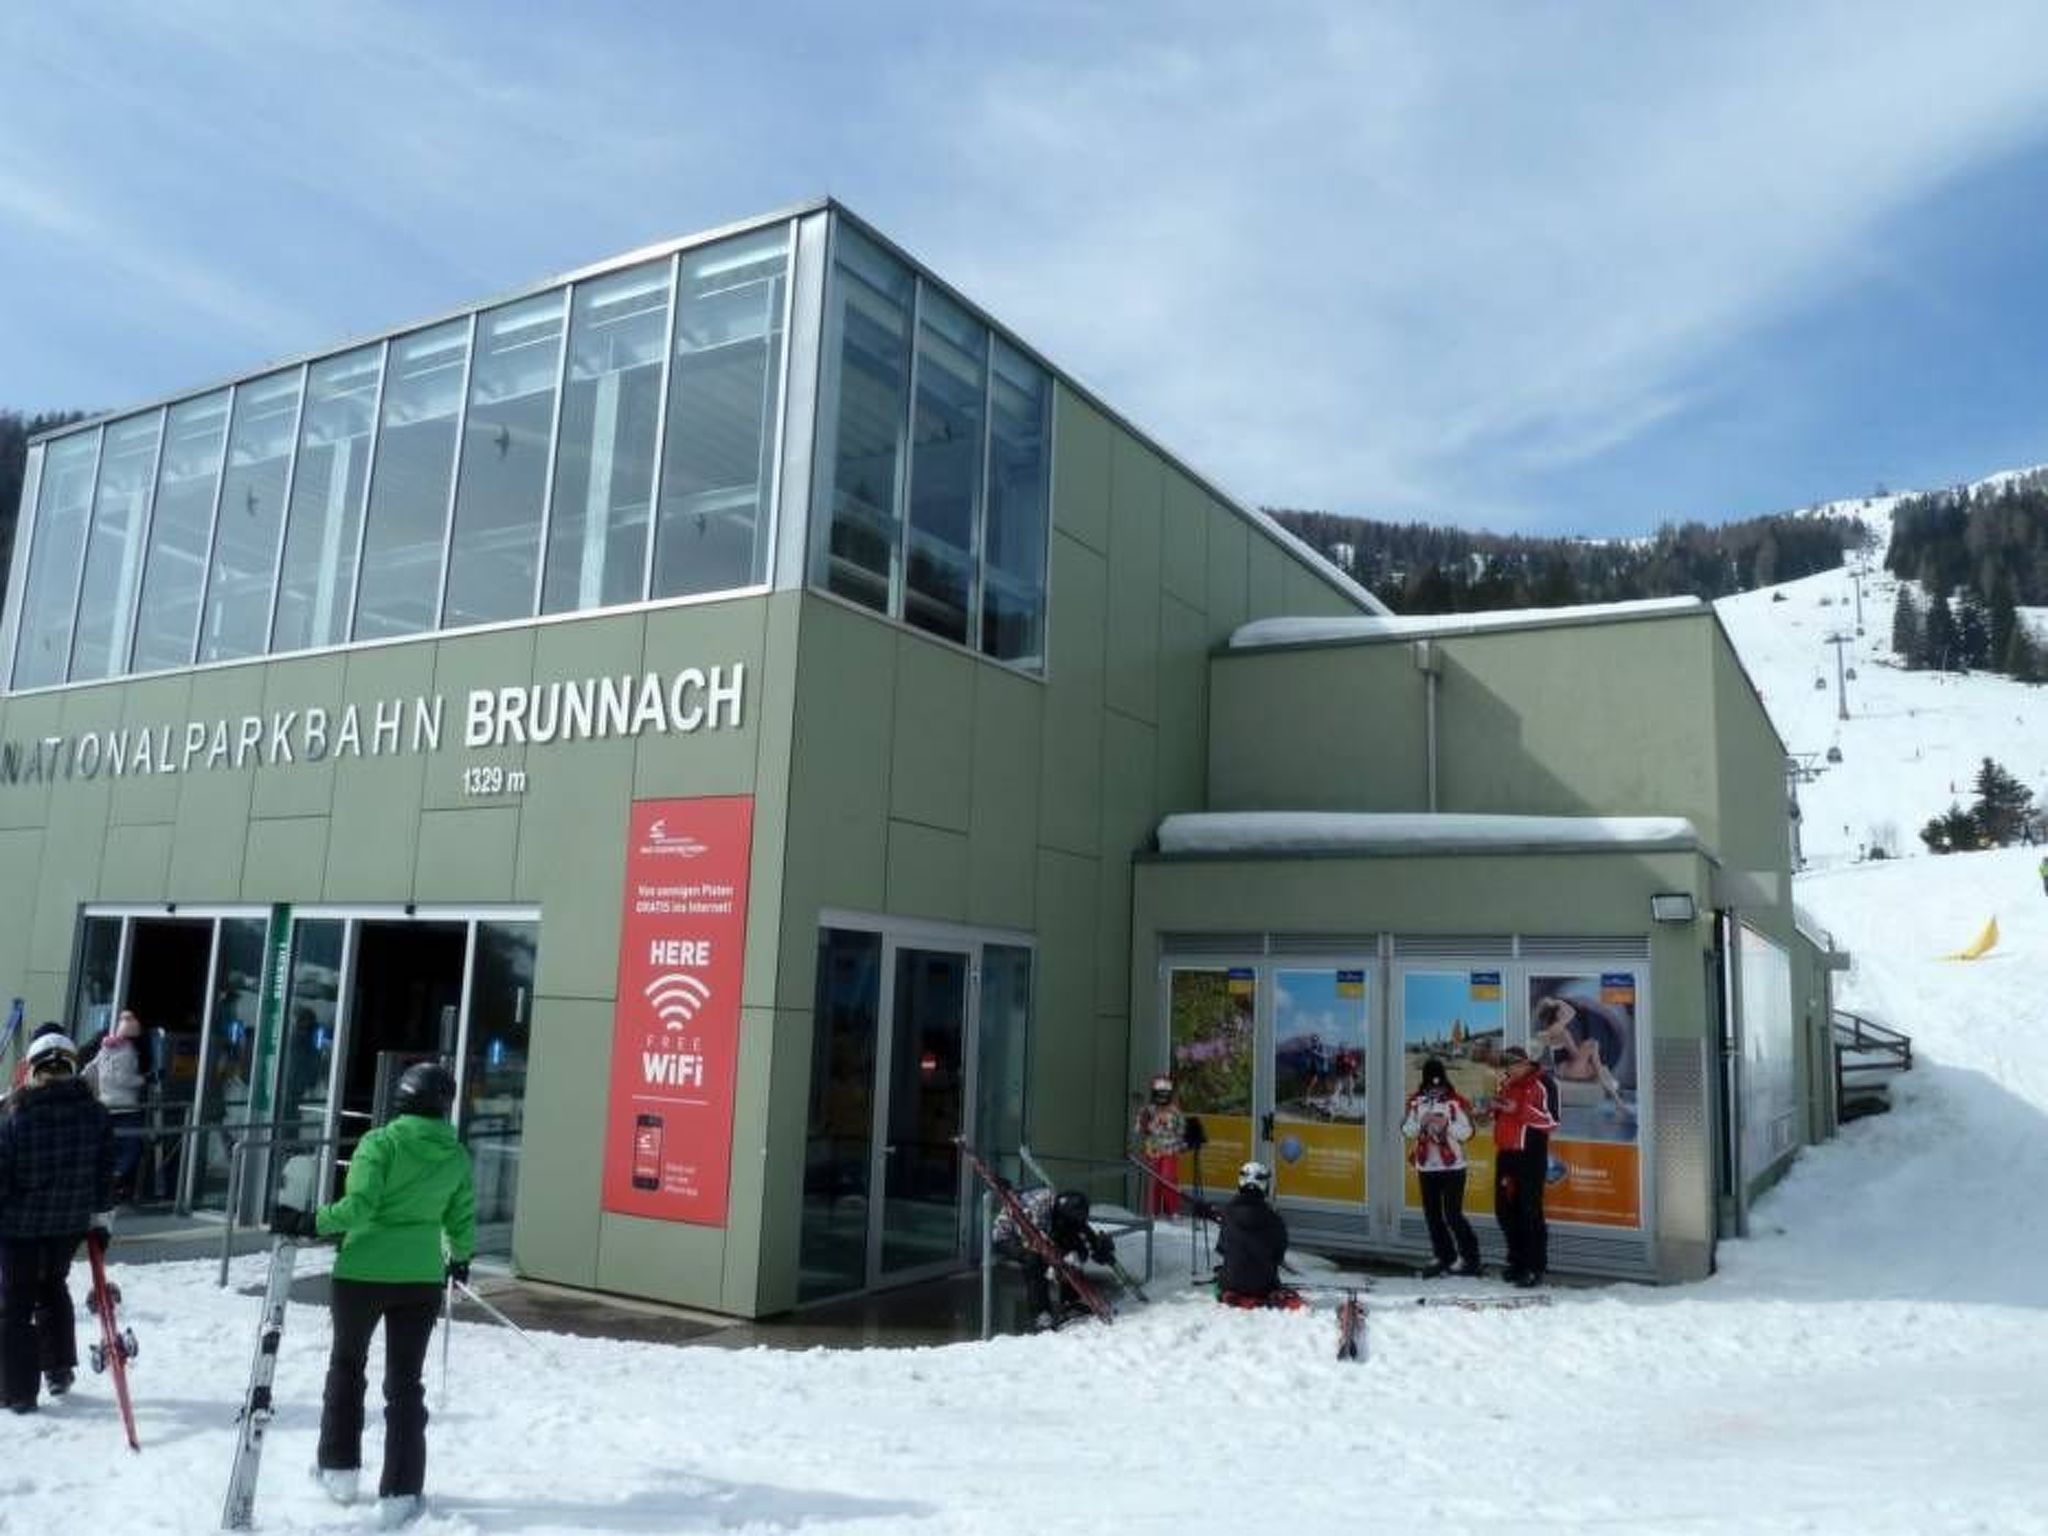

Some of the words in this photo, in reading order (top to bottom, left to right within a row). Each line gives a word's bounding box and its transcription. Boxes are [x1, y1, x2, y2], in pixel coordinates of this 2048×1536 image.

[0, 696, 443, 785] NATIONALPARKBAHN
[465, 662, 744, 747] BRUNNACH
[462, 766, 503, 794] 1329
[506, 769, 527, 793] m
[649, 939, 711, 967] HERE
[646, 1034, 702, 1052] FREE
[642, 1051, 704, 1088] WiFi
